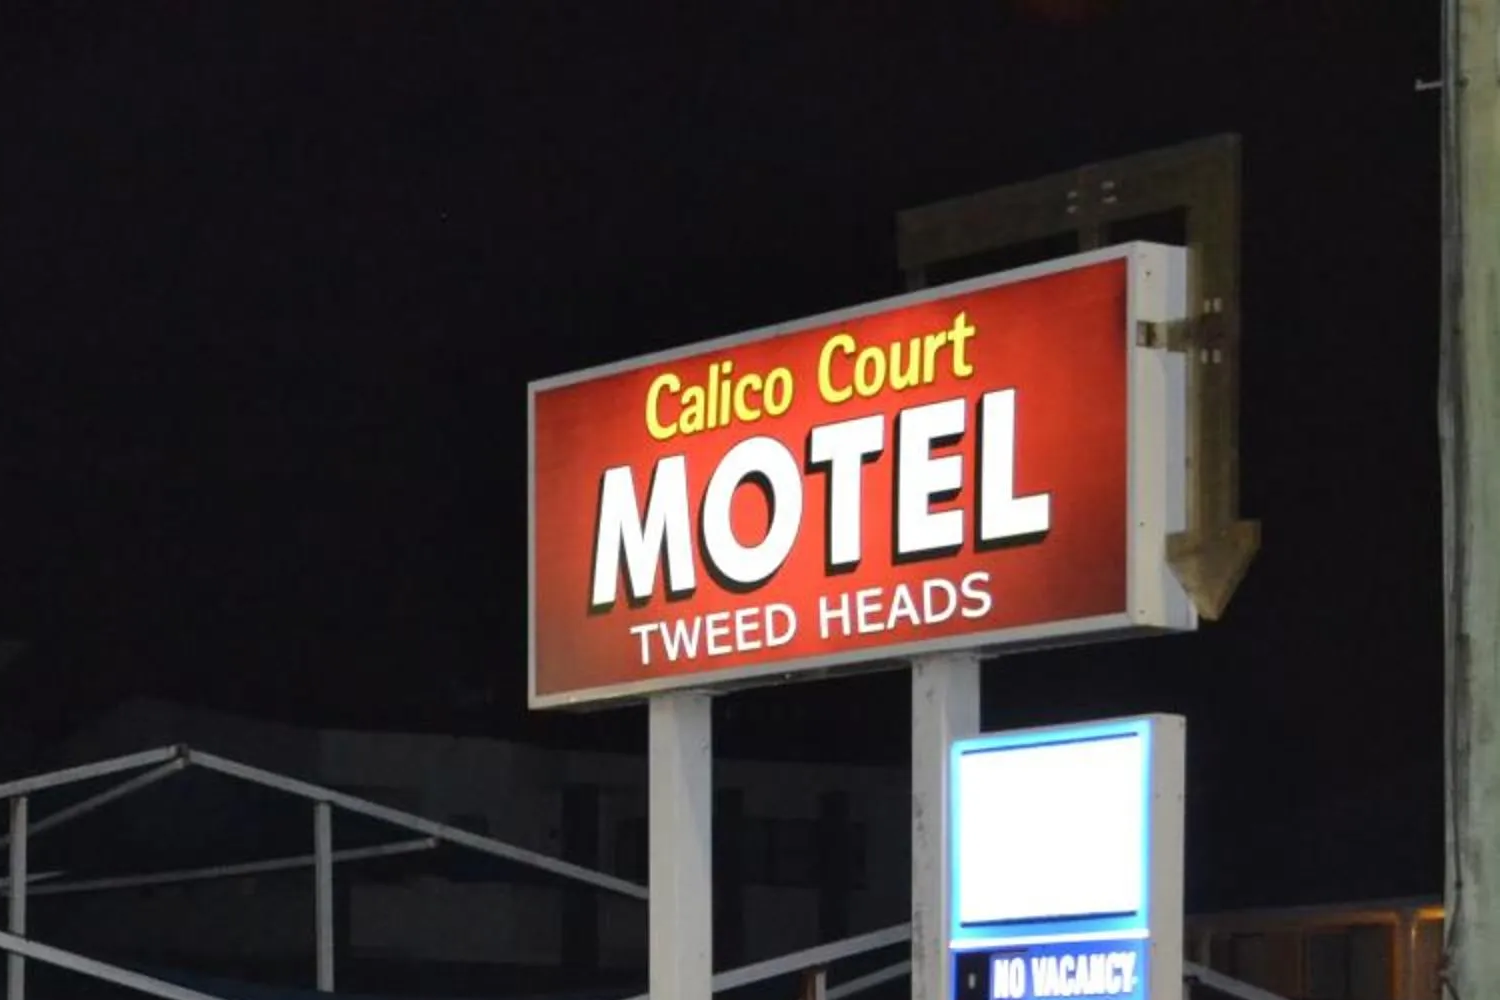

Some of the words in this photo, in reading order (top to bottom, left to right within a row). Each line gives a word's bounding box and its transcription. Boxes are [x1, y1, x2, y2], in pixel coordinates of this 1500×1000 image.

[645, 360, 794, 441] Calico
[817, 312, 976, 404] Court
[589, 387, 1051, 608] MOTEL
[630, 602, 797, 666] TWEED
[818, 571, 993, 640] HEADS
[993, 957, 1026, 999] NO
[1031, 951, 1137, 998] VACANCY
